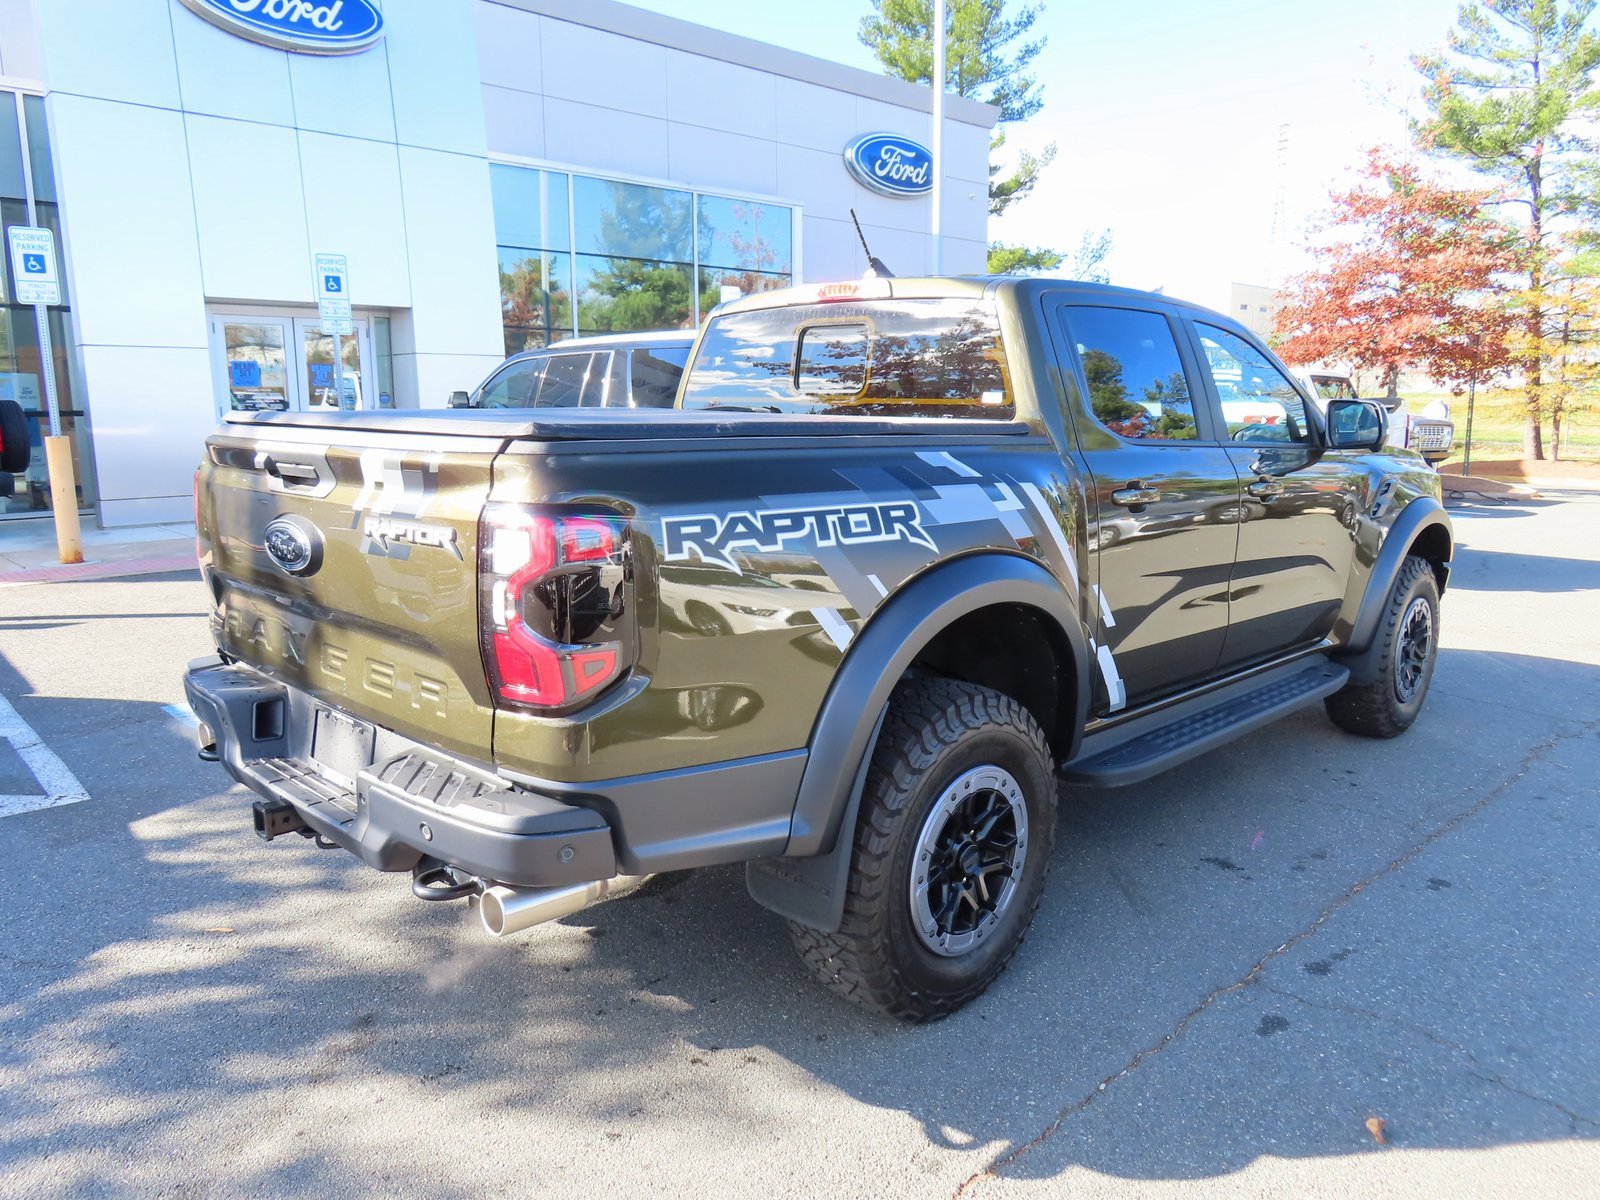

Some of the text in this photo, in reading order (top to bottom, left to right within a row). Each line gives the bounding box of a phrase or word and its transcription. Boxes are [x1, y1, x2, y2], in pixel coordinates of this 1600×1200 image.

[875, 145, 928, 184] Ford
[12, 232, 50, 242] RESERVED
[16, 243, 49, 251] PARKING
[270, 531, 297, 560] Ford
[364, 518, 464, 561] RAPTOR
[661, 500, 940, 576] RAPTOR
[224, 607, 449, 718] RANGER
